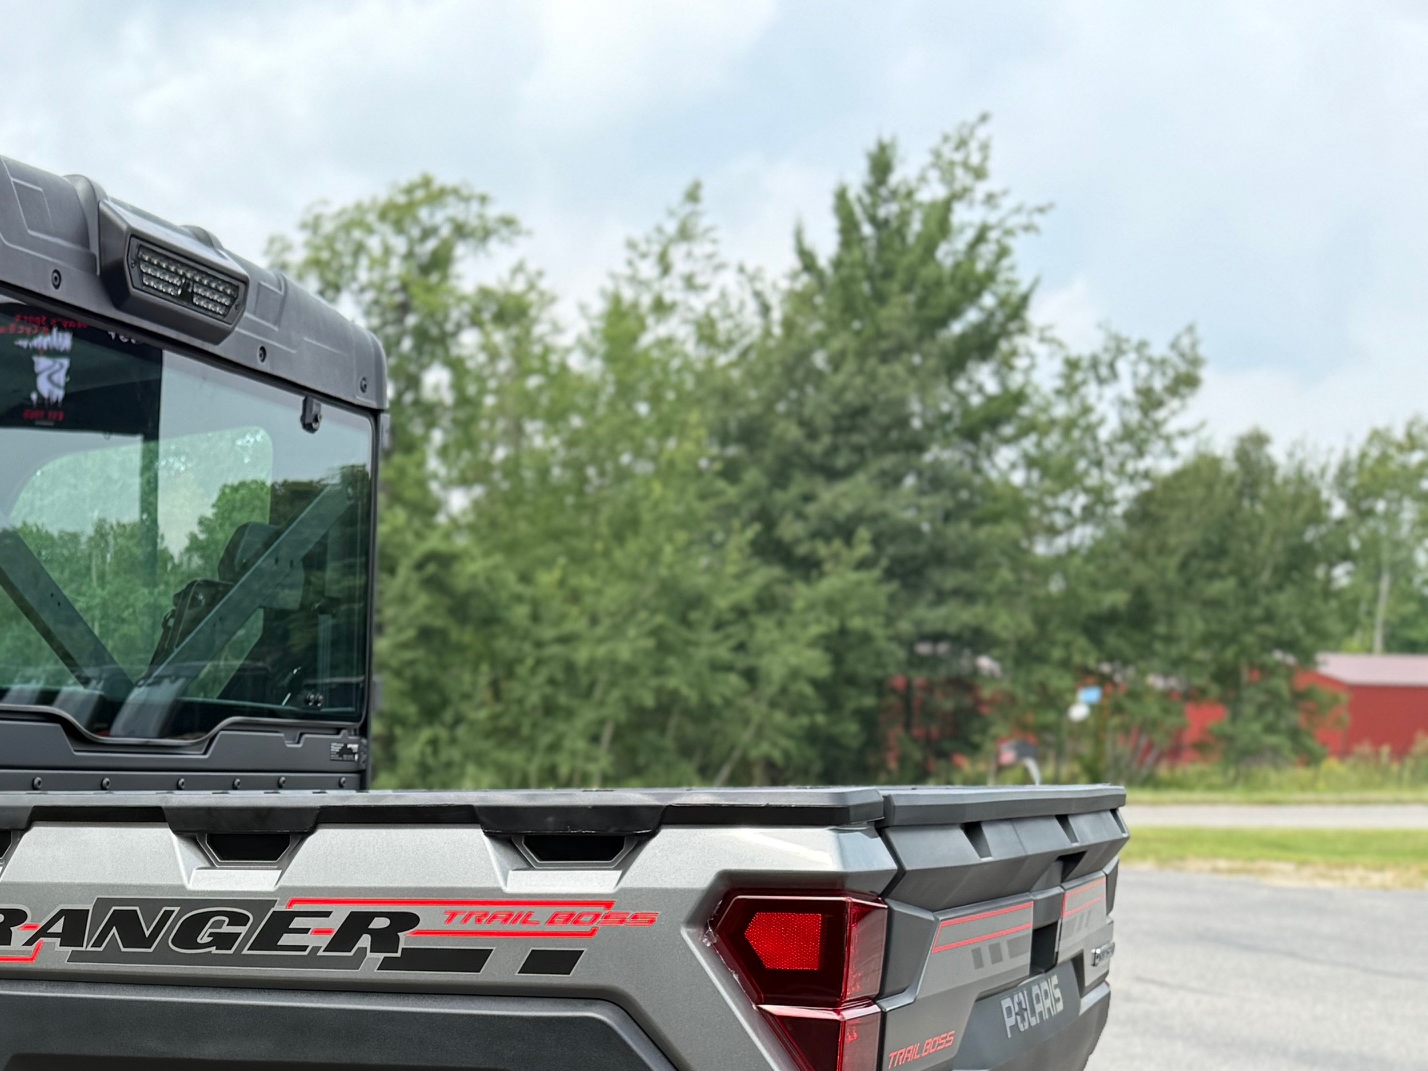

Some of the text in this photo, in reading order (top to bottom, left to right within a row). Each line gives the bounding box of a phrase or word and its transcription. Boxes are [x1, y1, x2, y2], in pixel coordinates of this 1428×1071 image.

[443, 909, 662, 927] TRAIL BOSS
[1000, 973, 1065, 1039] POLARIS
[888, 1030, 956, 1070] TRAIL BOSS
